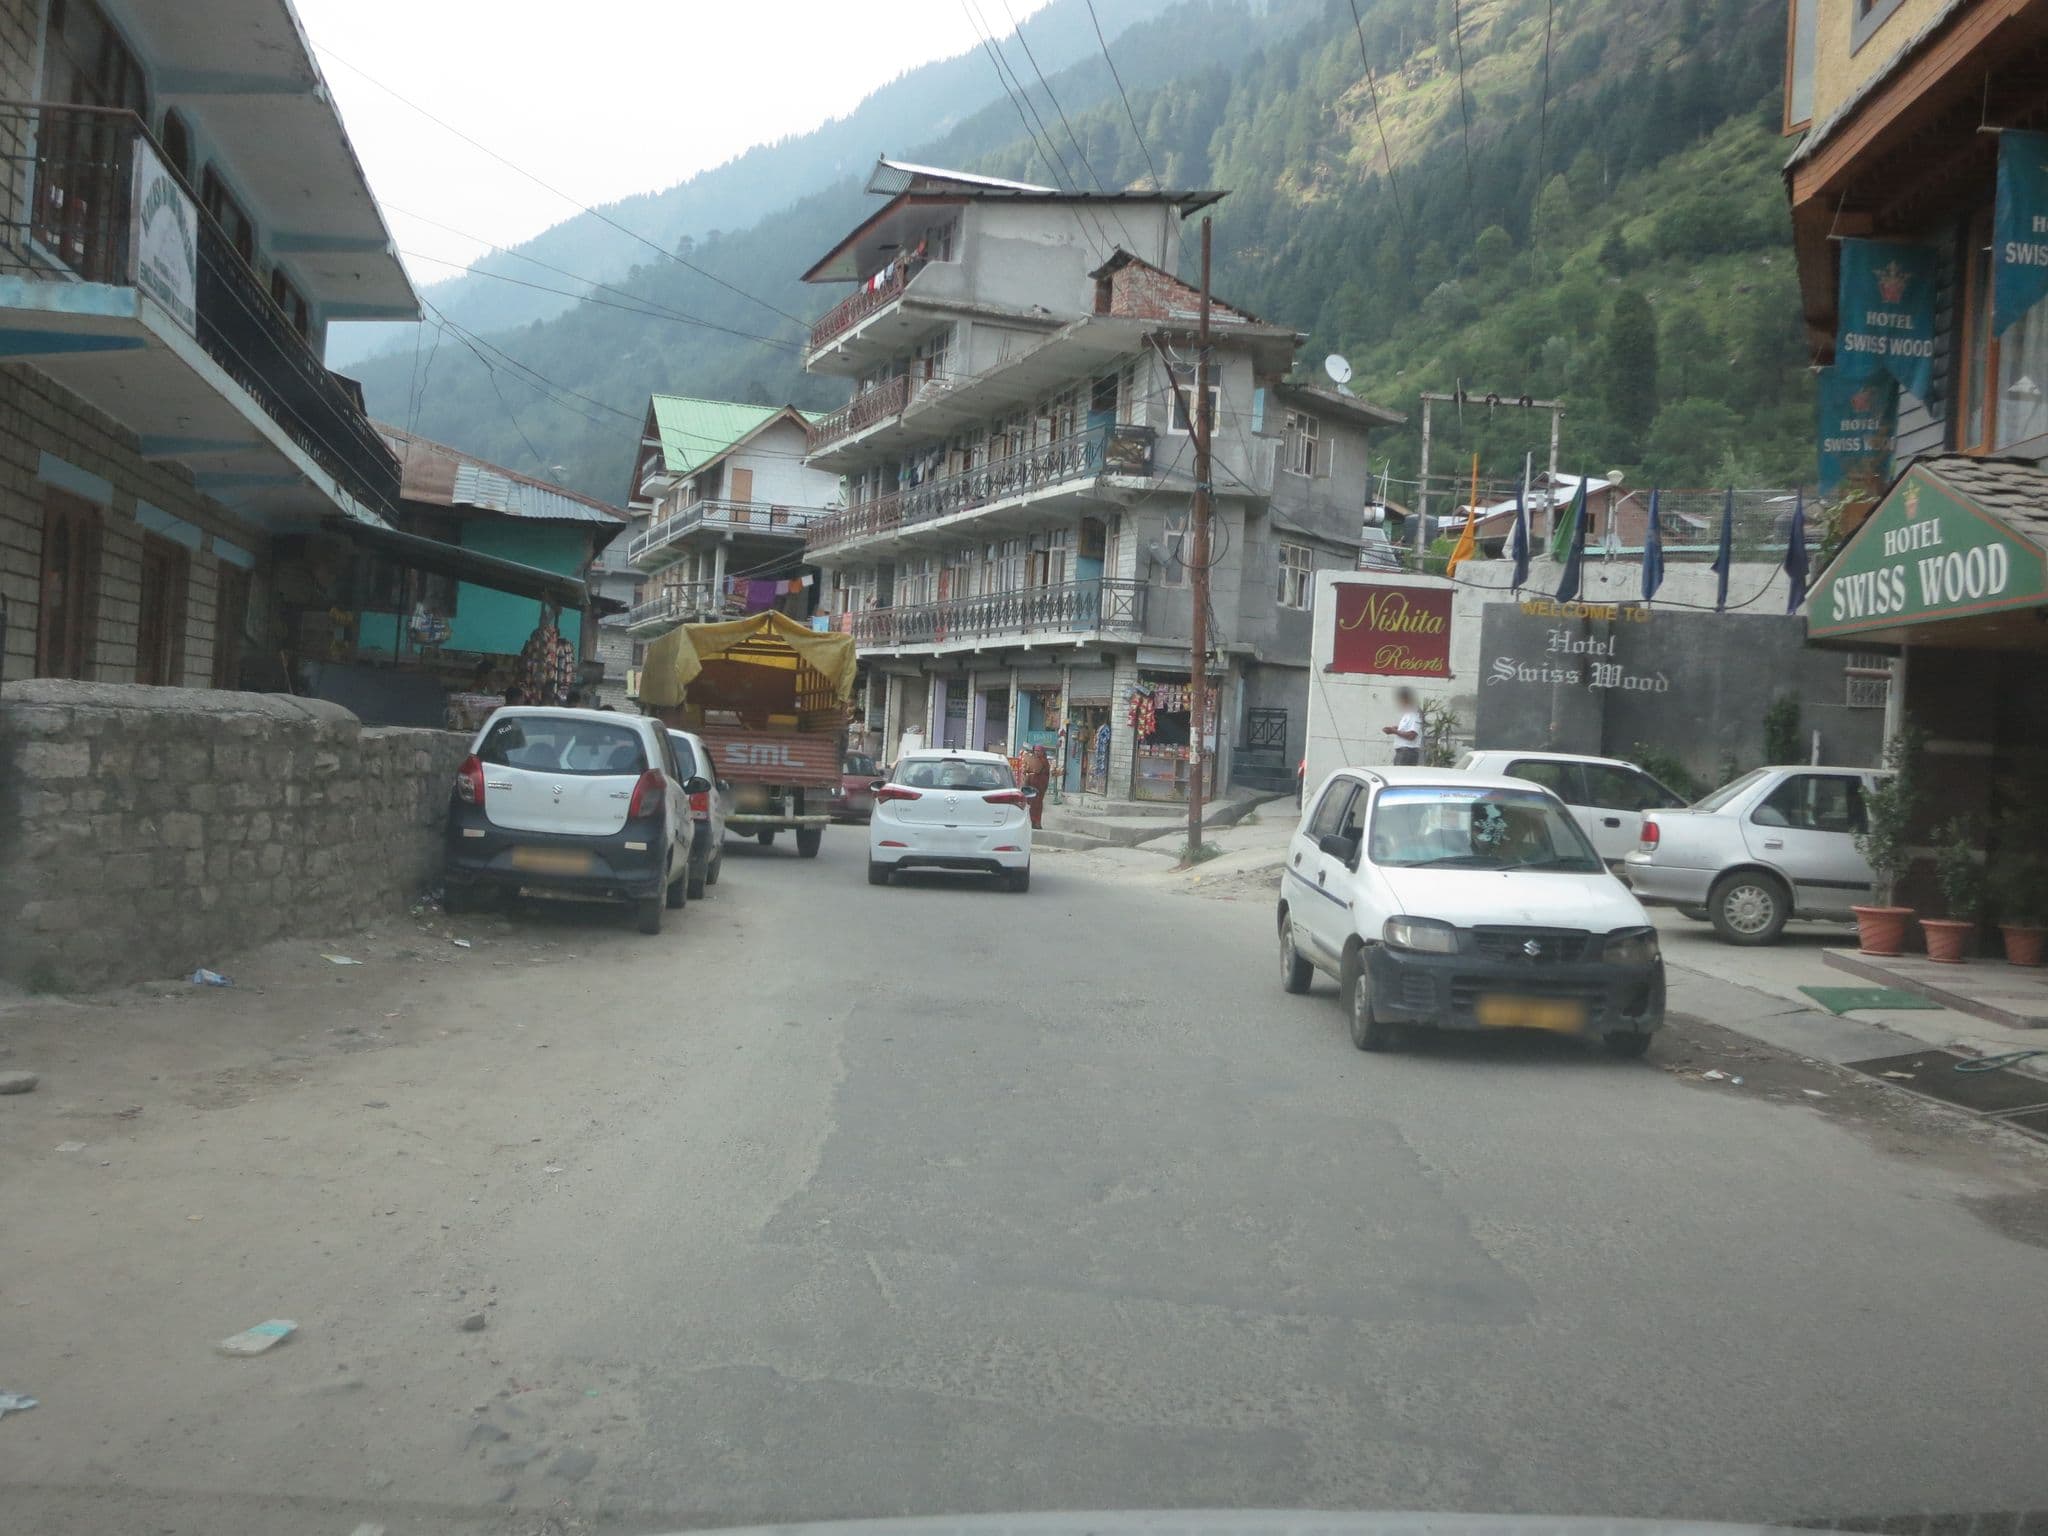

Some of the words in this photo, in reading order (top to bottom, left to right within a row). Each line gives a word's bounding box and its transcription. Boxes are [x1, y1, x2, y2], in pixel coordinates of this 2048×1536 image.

[2033, 215, 2048, 232] H
[1866, 311, 1913, 329] HOTEL
[1844, 333, 1886, 354] SWISS
[1889, 338, 1933, 357] WOOD
[1824, 437, 1861, 452] SWISS
[1884, 518, 1942, 557] HOTEL
[1832, 564, 1906, 621] SWISS
[1918, 542, 2008, 606] WOOD
[1339, 592, 1446, 634] Nishita
[1520, 601, 1618, 621] WELCOME
[1624, 606, 1651, 623] TO
[1545, 626, 1617, 657] Hotel
[1374, 644, 1443, 672] Resorts
[1487, 656, 1581, 686] Swiss
[1588, 662, 1669, 693] Wood
[724, 743, 805, 768] SML
